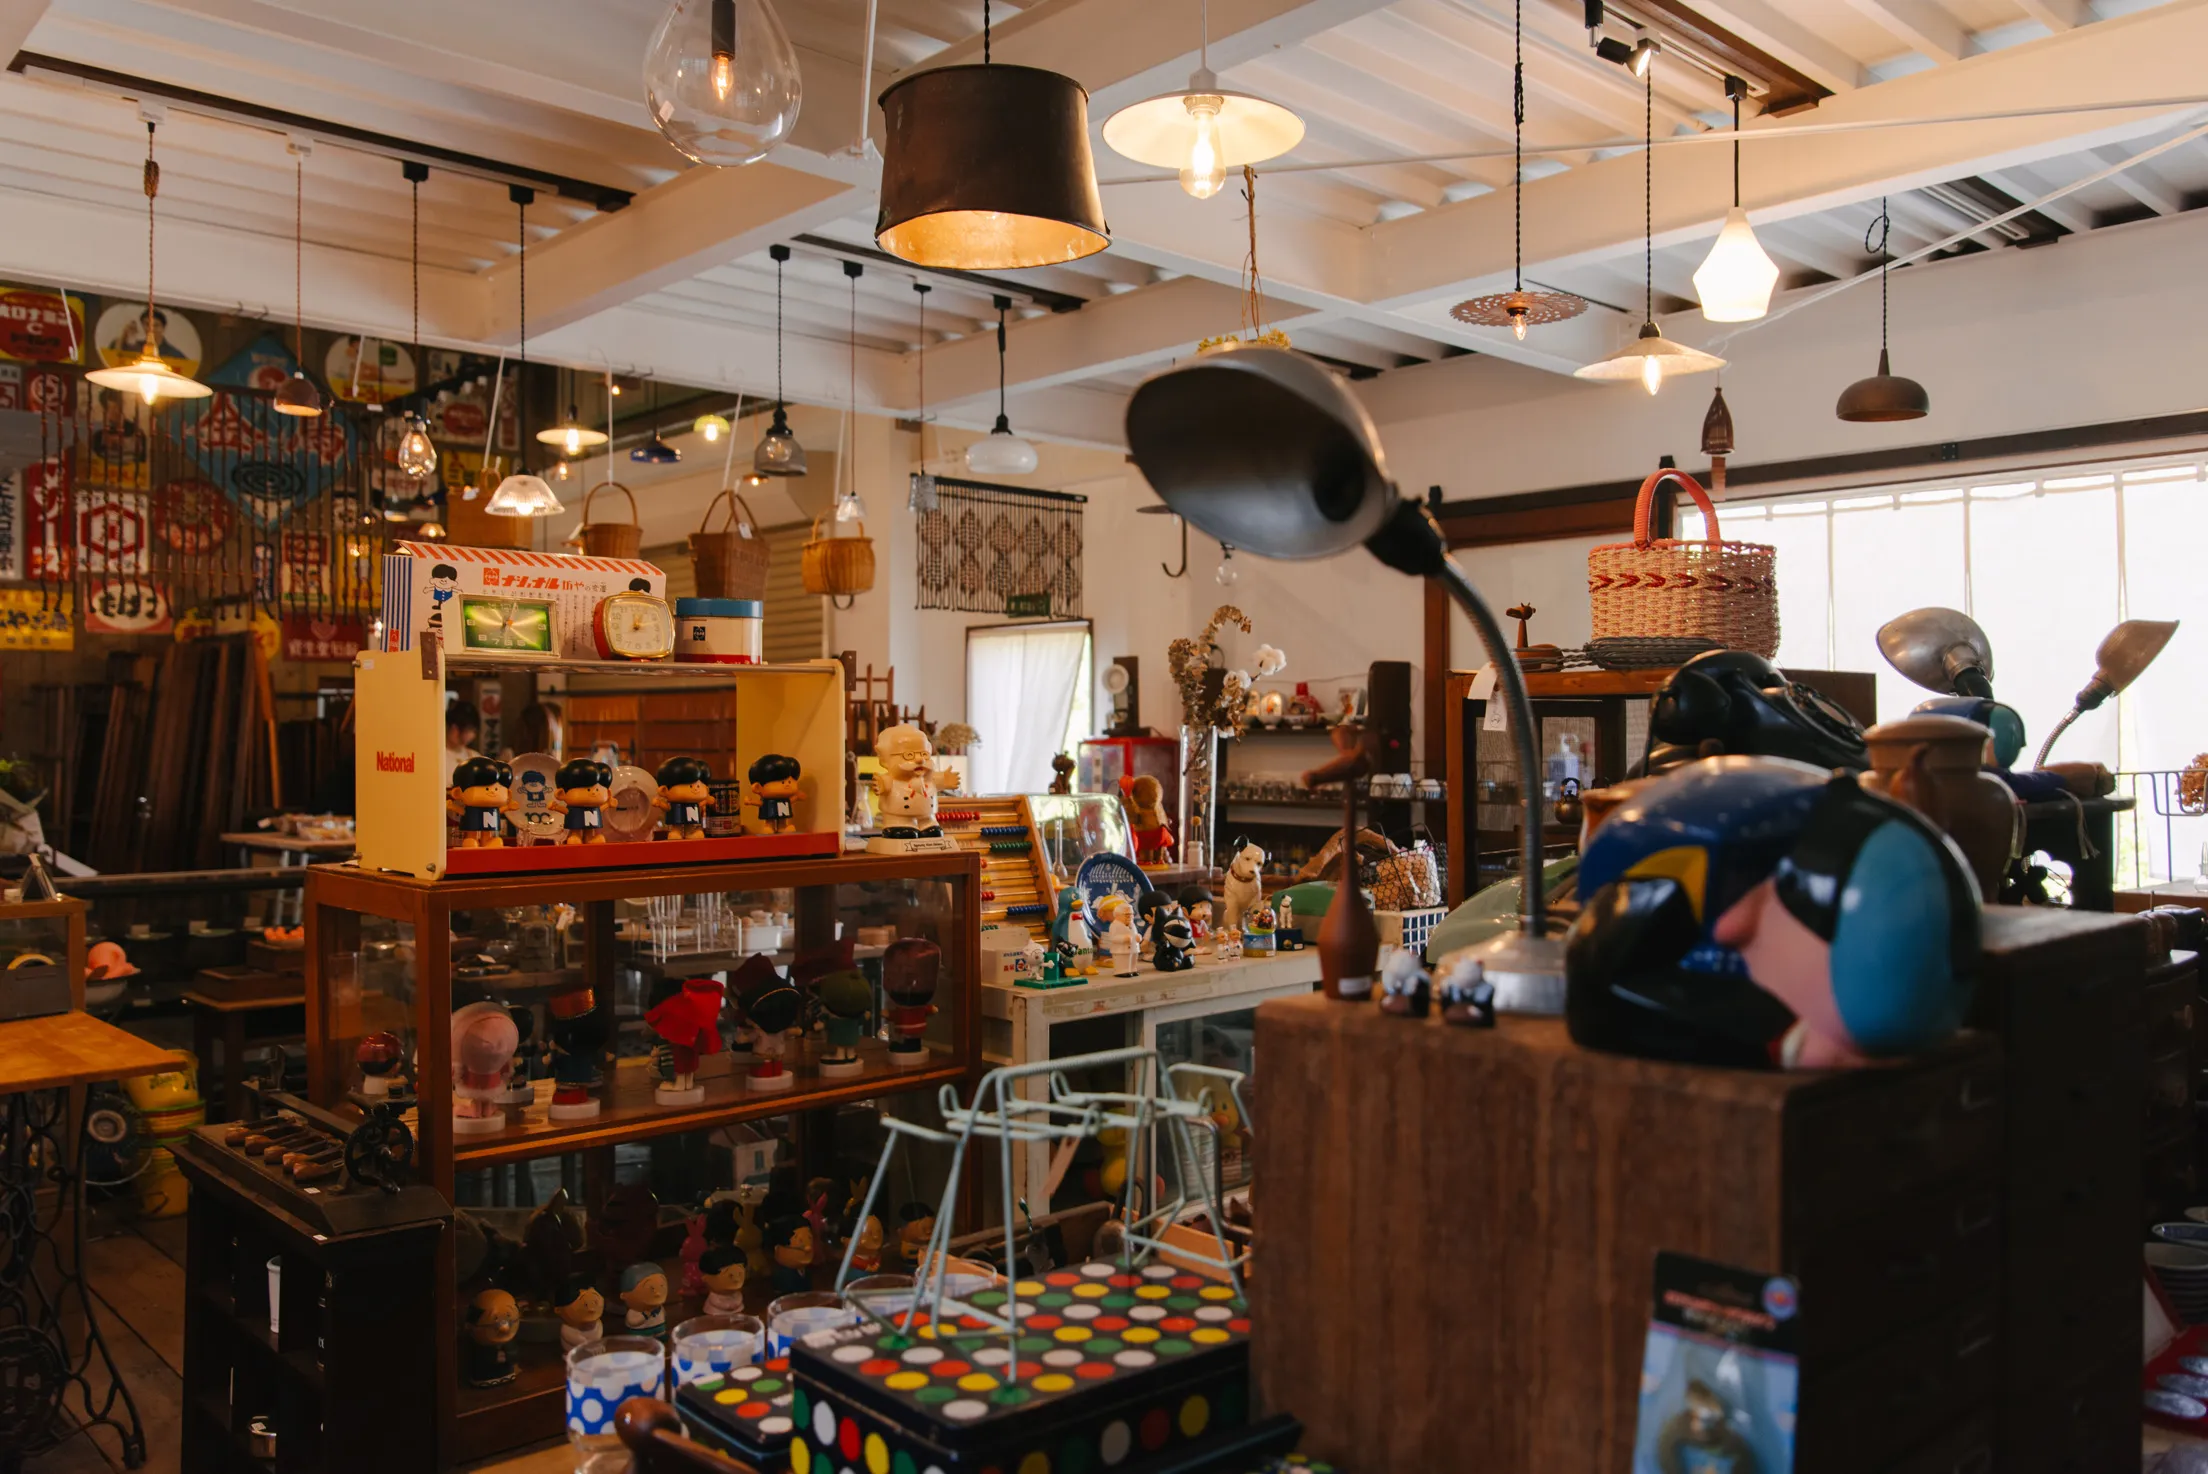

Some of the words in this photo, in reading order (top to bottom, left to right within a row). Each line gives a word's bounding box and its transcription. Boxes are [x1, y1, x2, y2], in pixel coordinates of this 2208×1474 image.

[376, 751, 415, 773] National
[686, 806, 700, 823] N
[777, 802, 790, 817] N
[483, 811, 498, 828] N
[584, 810, 598, 827] N
